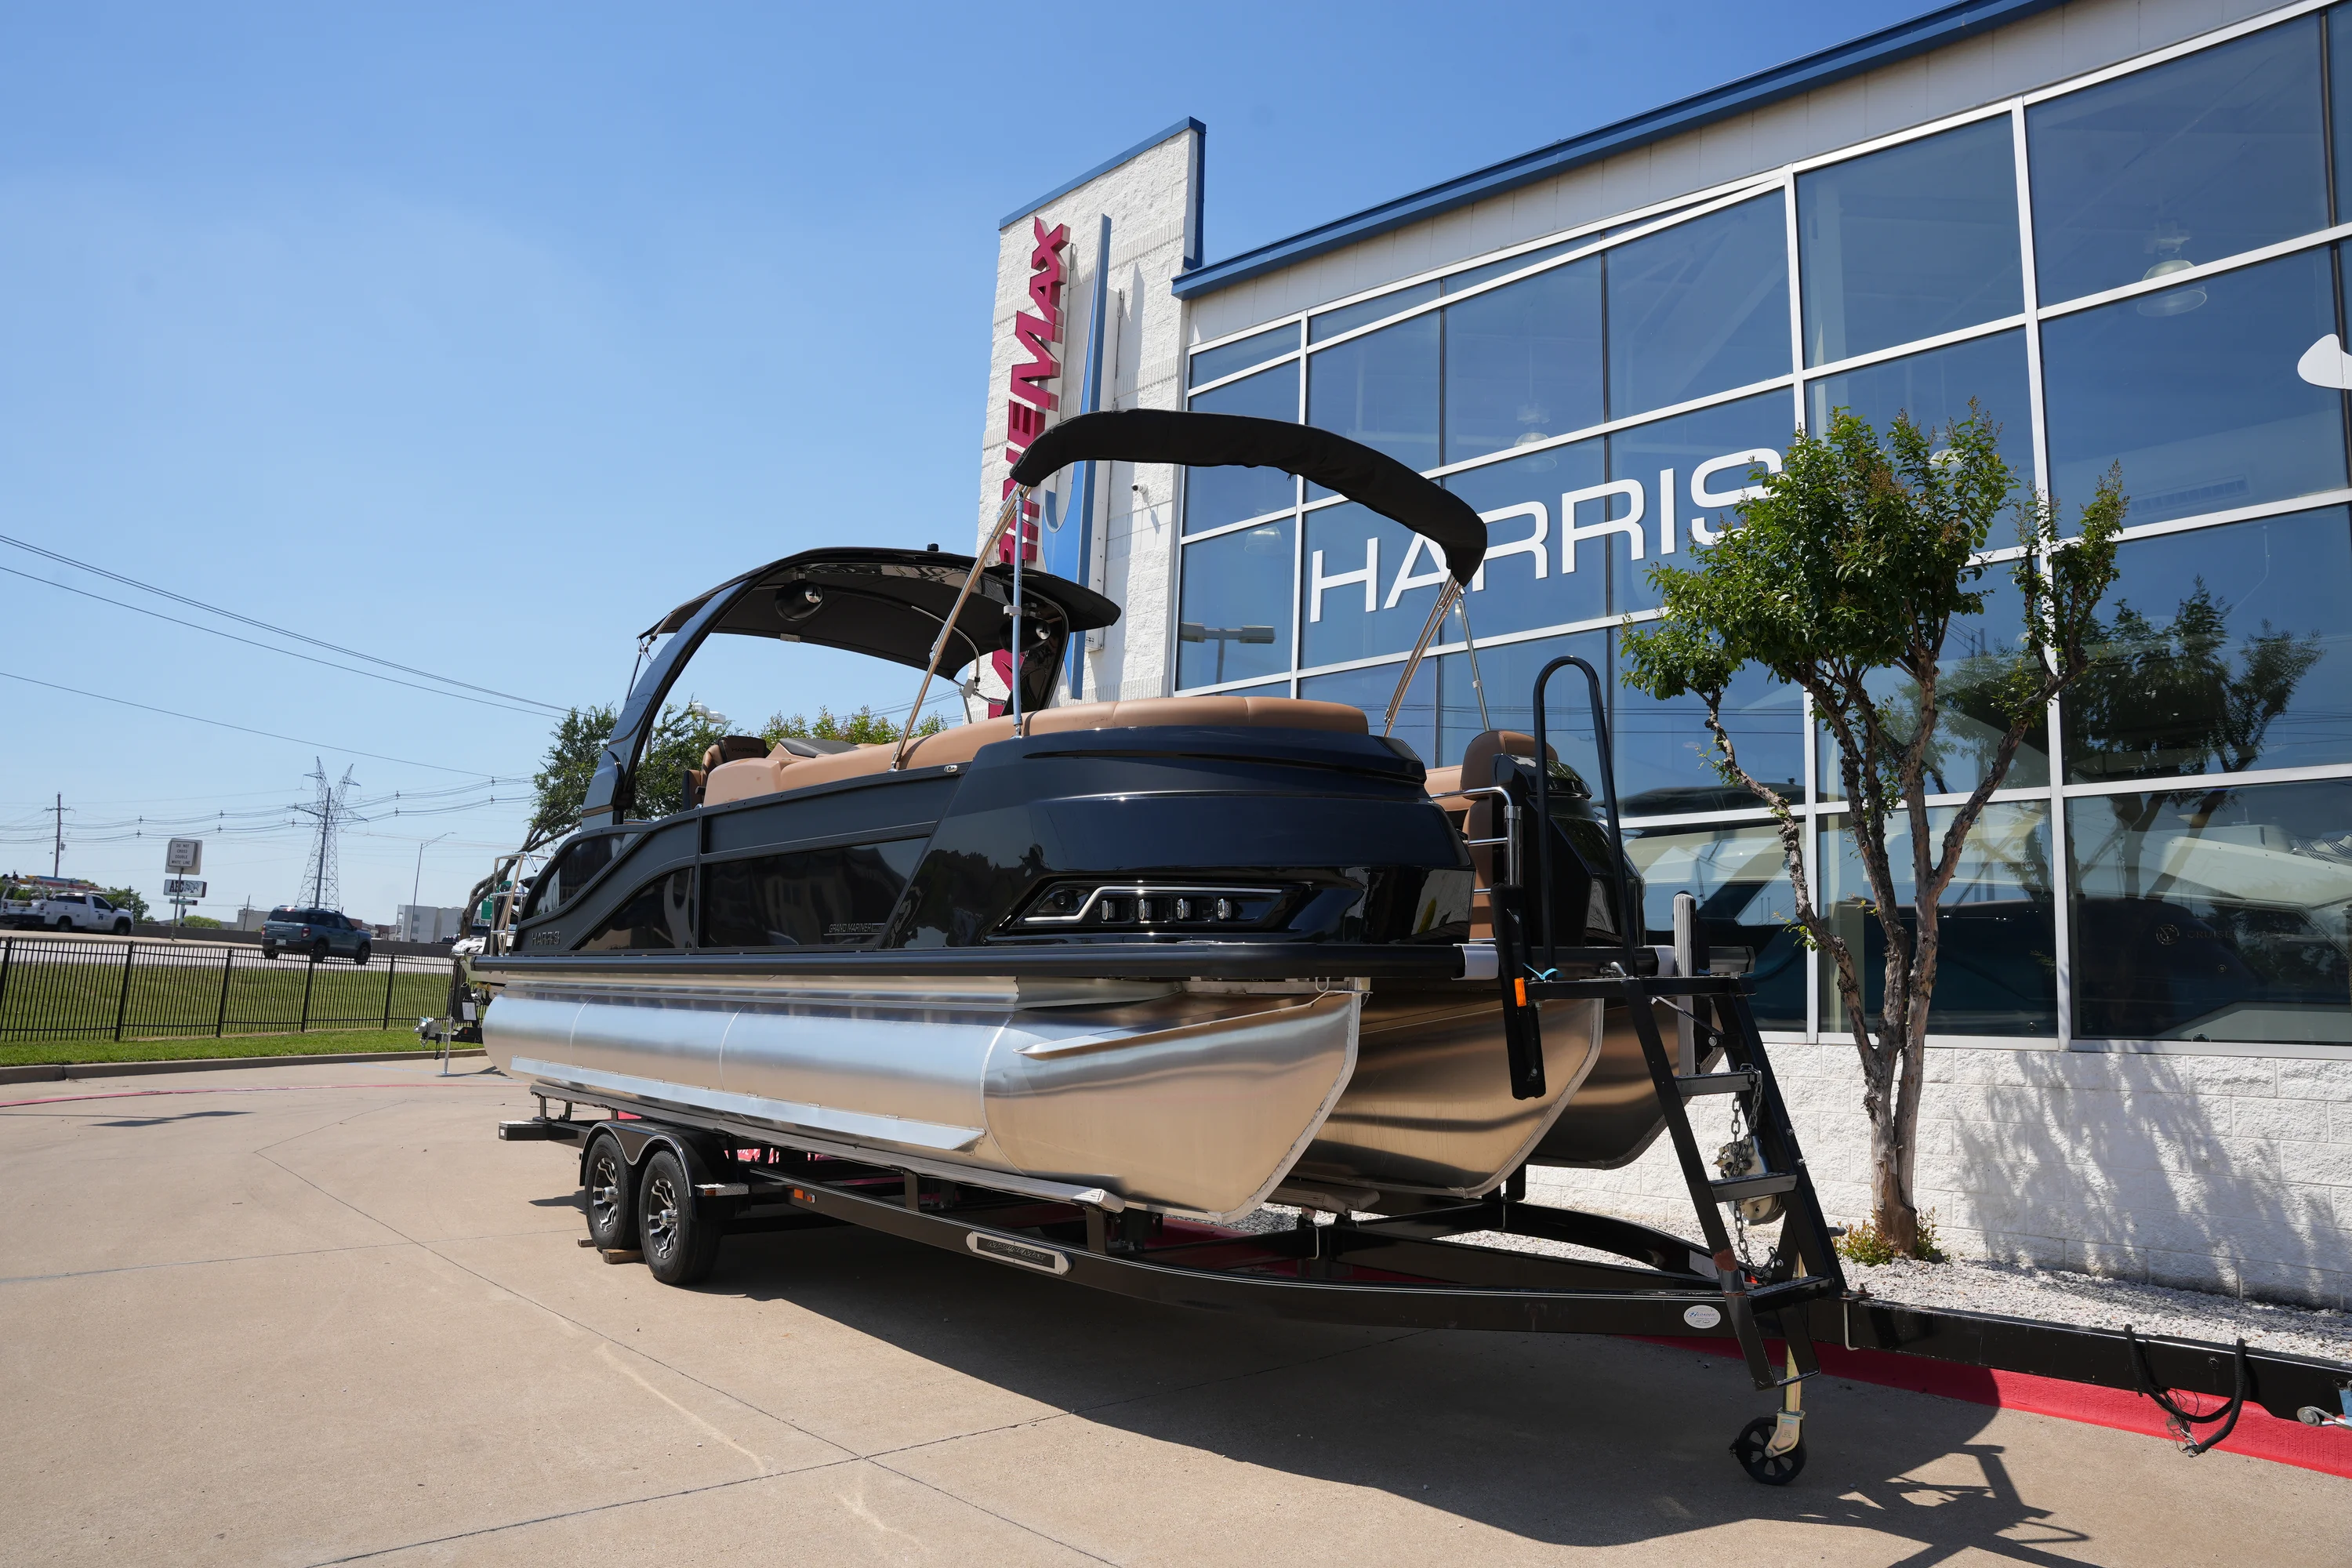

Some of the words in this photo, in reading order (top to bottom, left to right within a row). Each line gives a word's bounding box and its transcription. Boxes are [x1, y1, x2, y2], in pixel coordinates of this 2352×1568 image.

[1309, 448, 1783, 623] HARRIS
[829, 924, 848, 933] GRAND
[847, 923, 872, 933] MARINER
[532, 931, 560, 946] HARRIS
